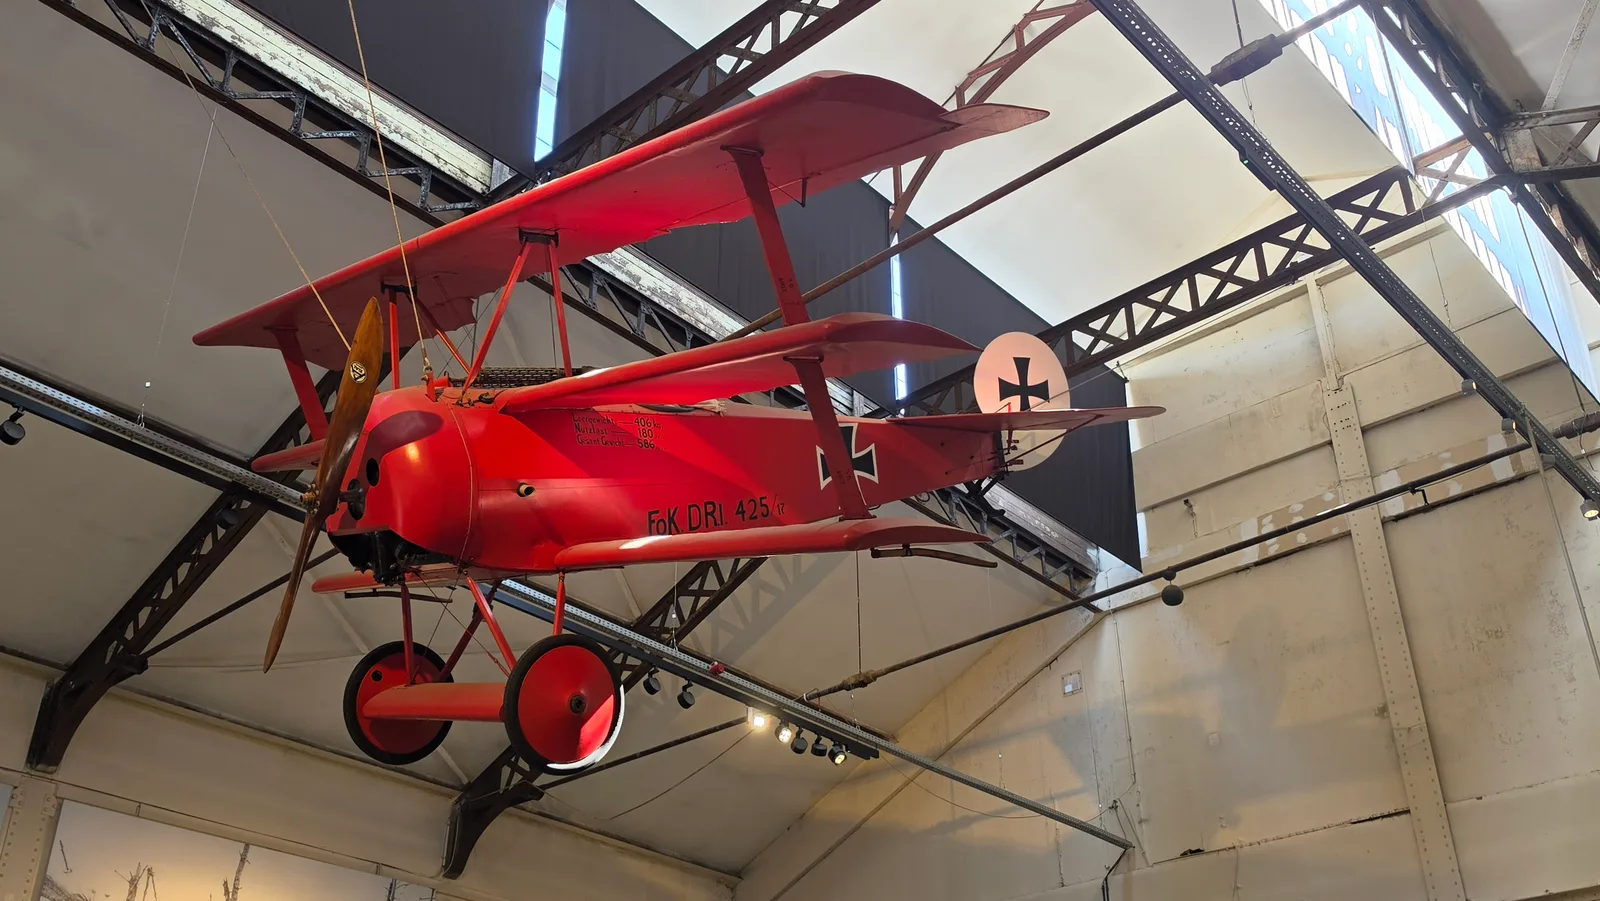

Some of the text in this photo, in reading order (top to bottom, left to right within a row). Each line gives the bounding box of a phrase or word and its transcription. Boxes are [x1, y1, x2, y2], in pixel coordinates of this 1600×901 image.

[634, 417, 652, 428] 406
[638, 428, 654, 439] 180
[637, 438, 655, 450] 586
